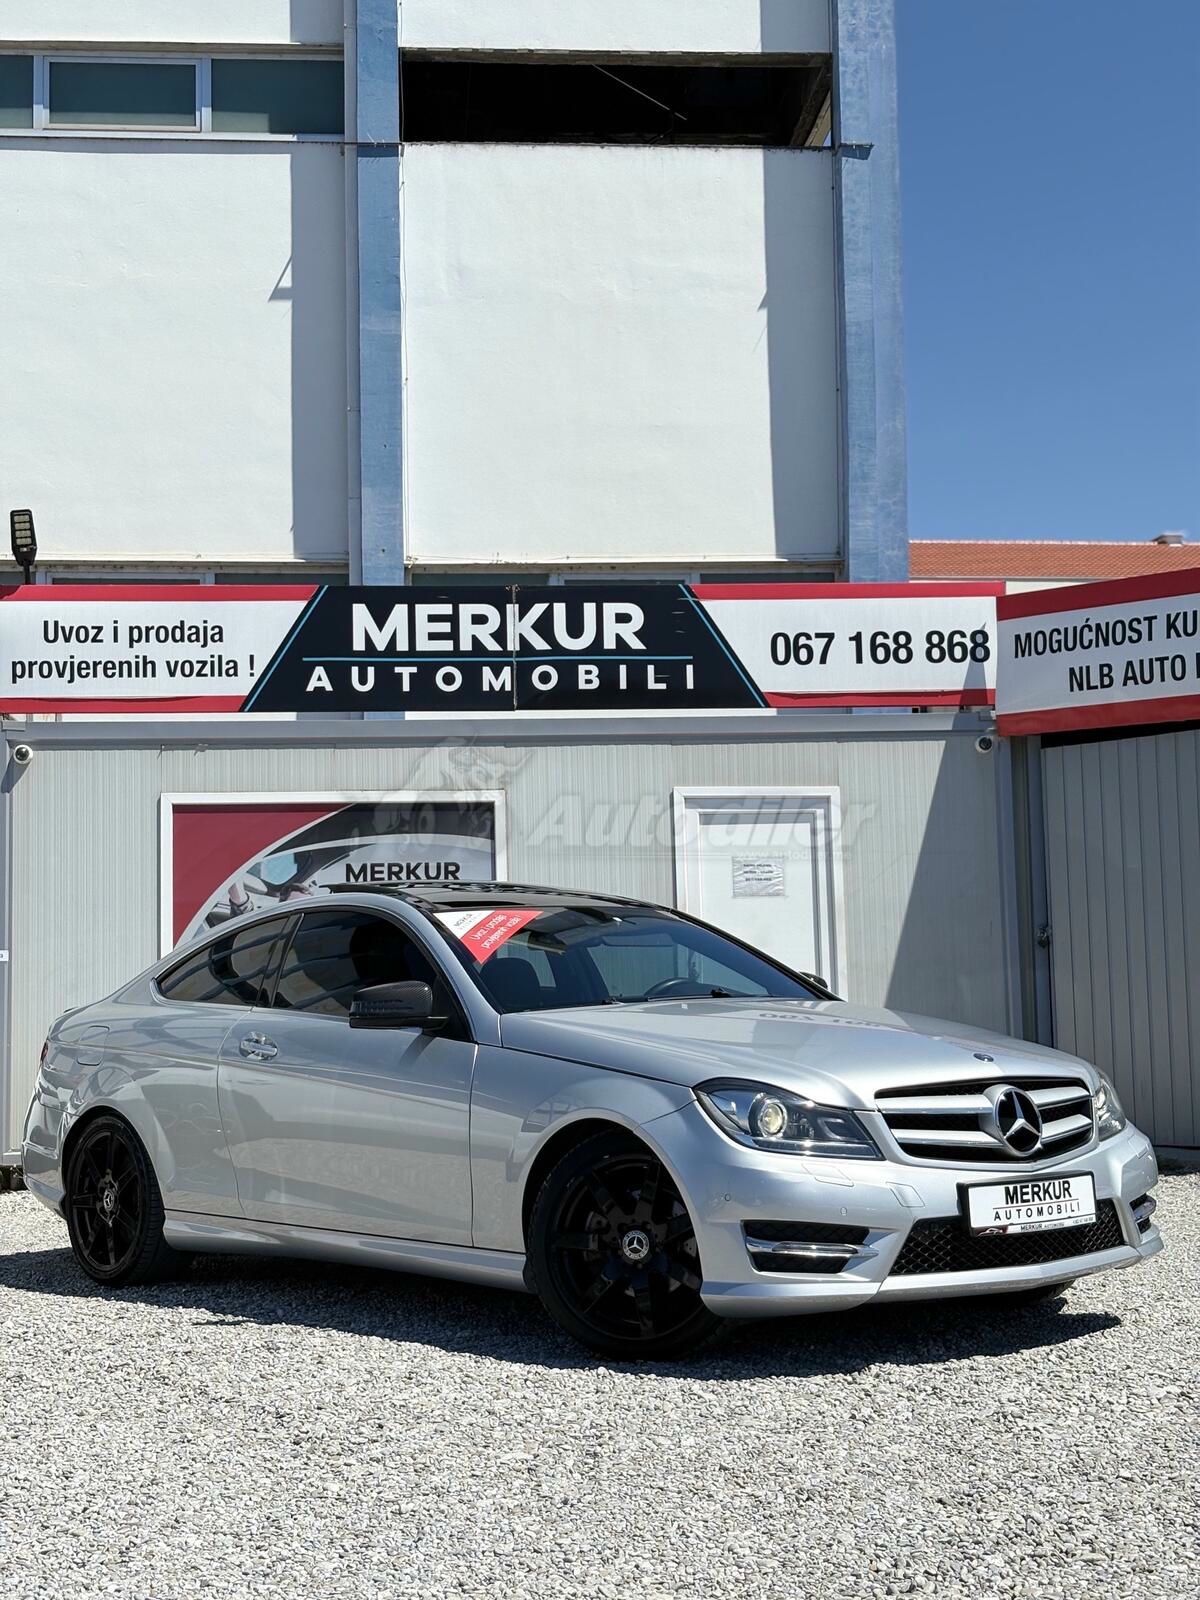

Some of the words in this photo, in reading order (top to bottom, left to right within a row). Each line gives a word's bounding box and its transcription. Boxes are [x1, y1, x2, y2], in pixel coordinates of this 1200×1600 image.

[43, 620, 104, 644] Uvoz
[113, 620, 119, 643] i
[128, 620, 224, 648] prodaja
[352, 602, 647, 652] MERKUR
[1014, 615, 1158, 658] MOGUĆNOST
[770, 632, 836, 666] 067
[848, 631, 913, 665] 168
[925, 629, 991, 663] 868
[11, 654, 157, 684] provjerenih
[166, 654, 239, 677] vozila
[306, 664, 694, 692] AUTOMOBILI
[1068, 663, 1114, 692] NLB
[1122, 654, 1187, 686] AUTO
[345, 861, 461, 882] MERKUR
[1004, 1180, 1072, 1205] MERKUR
[994, 1201, 1080, 1221] AUTOMOBILI
